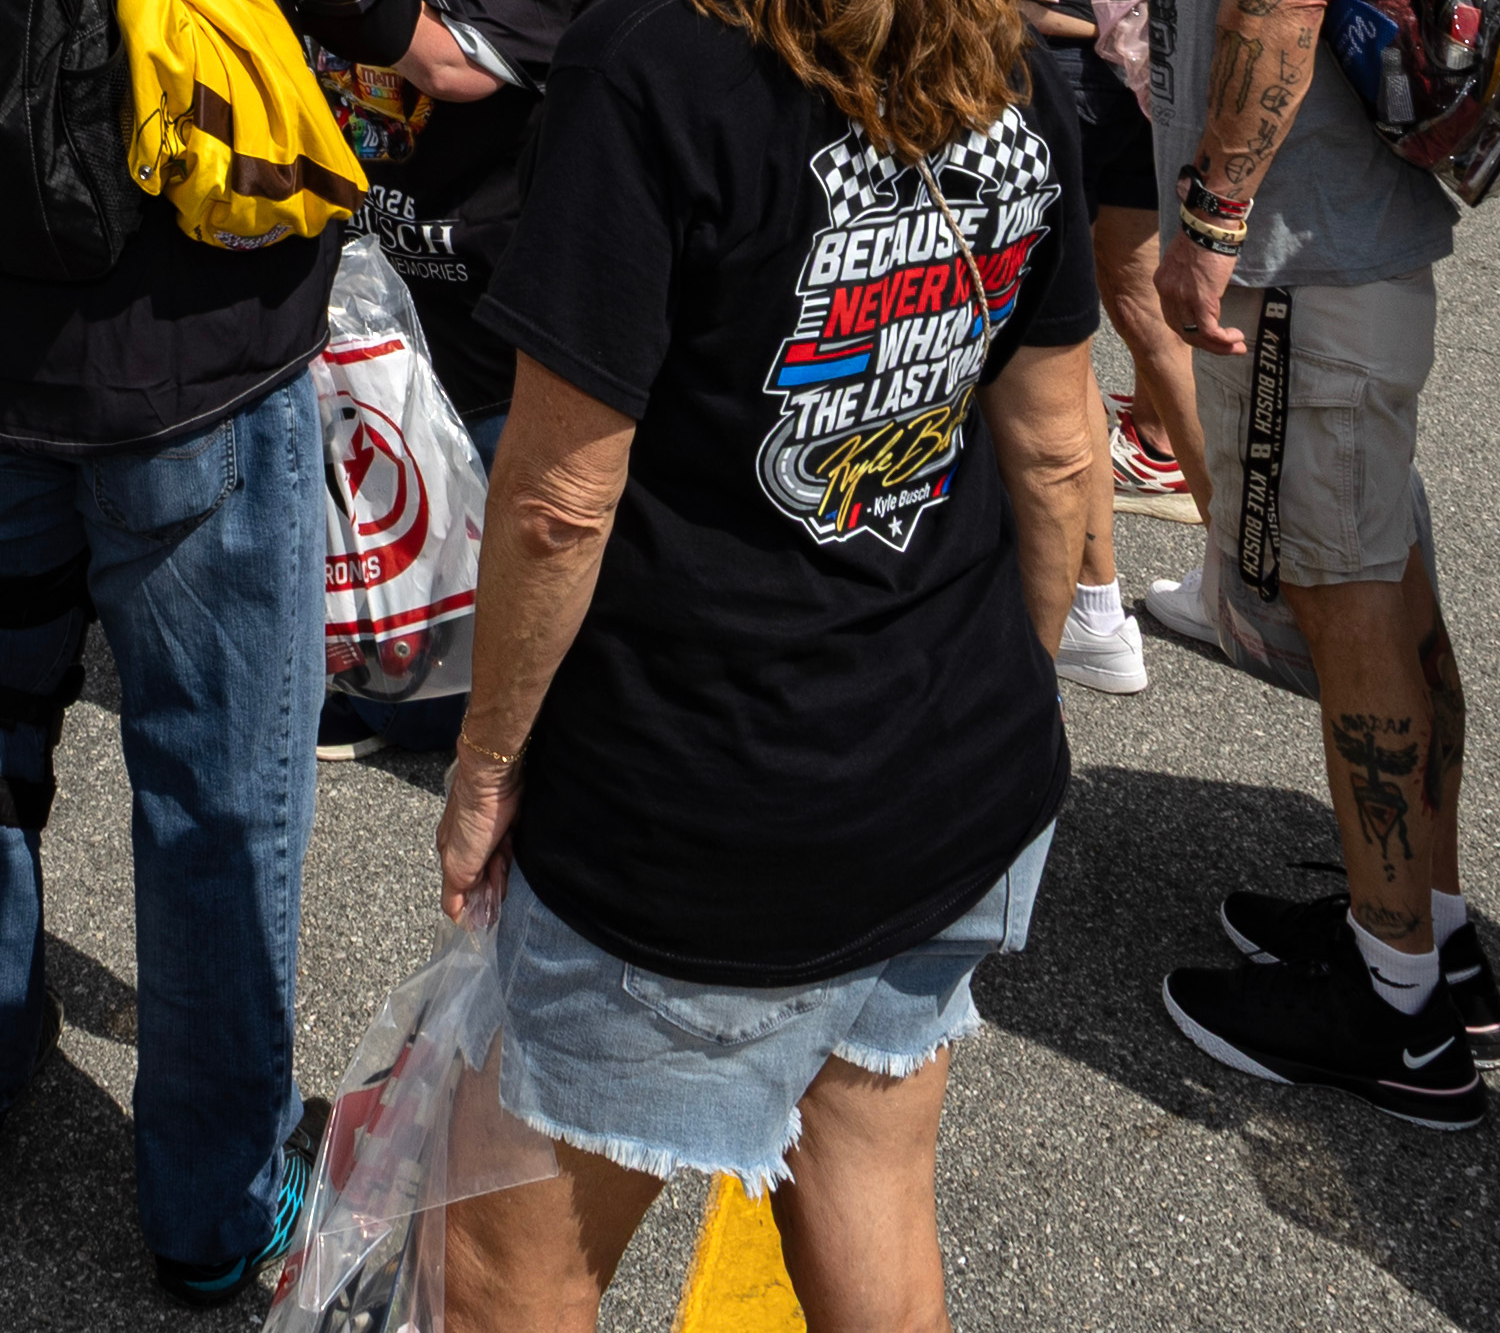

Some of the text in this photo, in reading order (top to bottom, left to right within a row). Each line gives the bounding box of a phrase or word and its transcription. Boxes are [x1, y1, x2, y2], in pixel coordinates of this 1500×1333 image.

[809, 192, 1056, 285] BECAUSE YOU
[824, 264, 949, 337] NEVER
[876, 302, 973, 373] WHEN
[1261, 328, 1280, 377] KYLE
[792, 387, 865, 439] THE
[866, 363, 947, 416] LAST
[1255, 376, 1275, 435] BUSCH
[873, 483, 931, 517] Kyle Busch
[1247, 469, 1267, 518] KYLE
[1243, 517, 1263, 578] BUSCH
